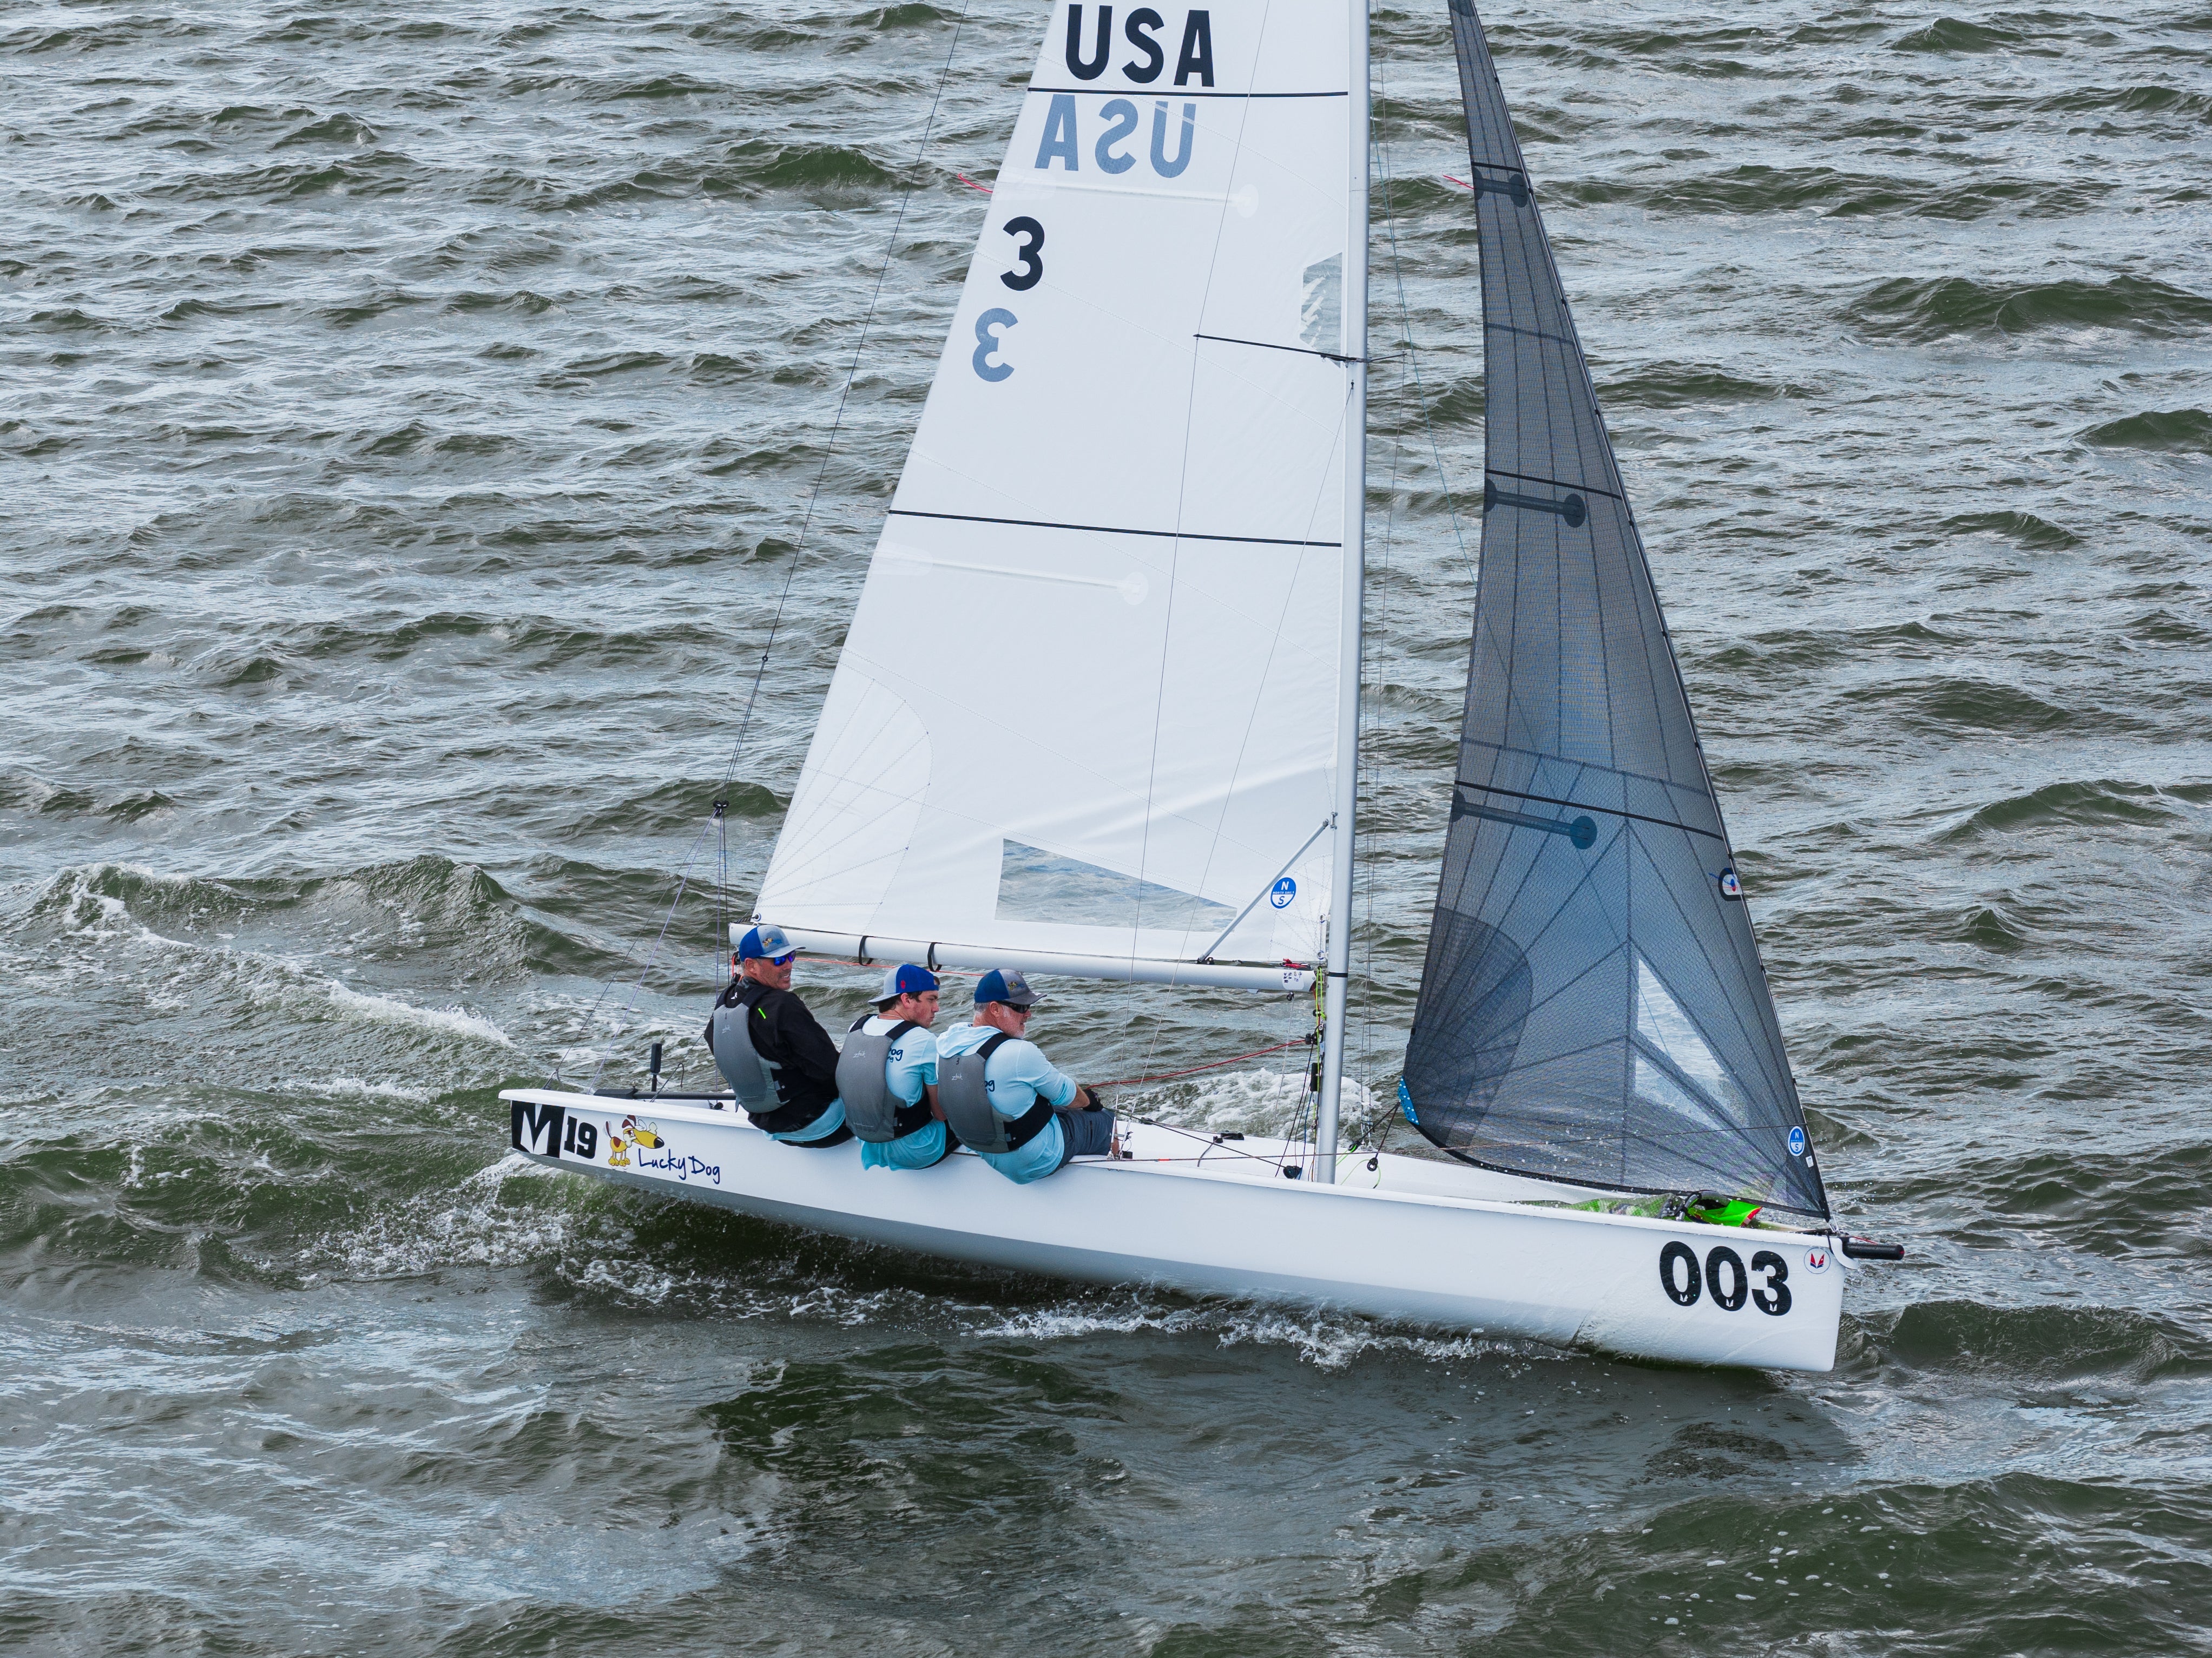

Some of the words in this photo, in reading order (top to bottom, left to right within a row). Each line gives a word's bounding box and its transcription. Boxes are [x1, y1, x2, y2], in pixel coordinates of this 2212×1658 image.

[1065, 4, 1214, 87] USA
[1000, 216, 1045, 291] 3
[1278, 896, 1285, 905] S
[1281, 881, 1289, 890] N
[888, 1048, 904, 1062] og
[638, 1148, 686, 1180] Lucky
[688, 1156, 720, 1185] Dog
[1659, 1241, 1793, 1316] 003
